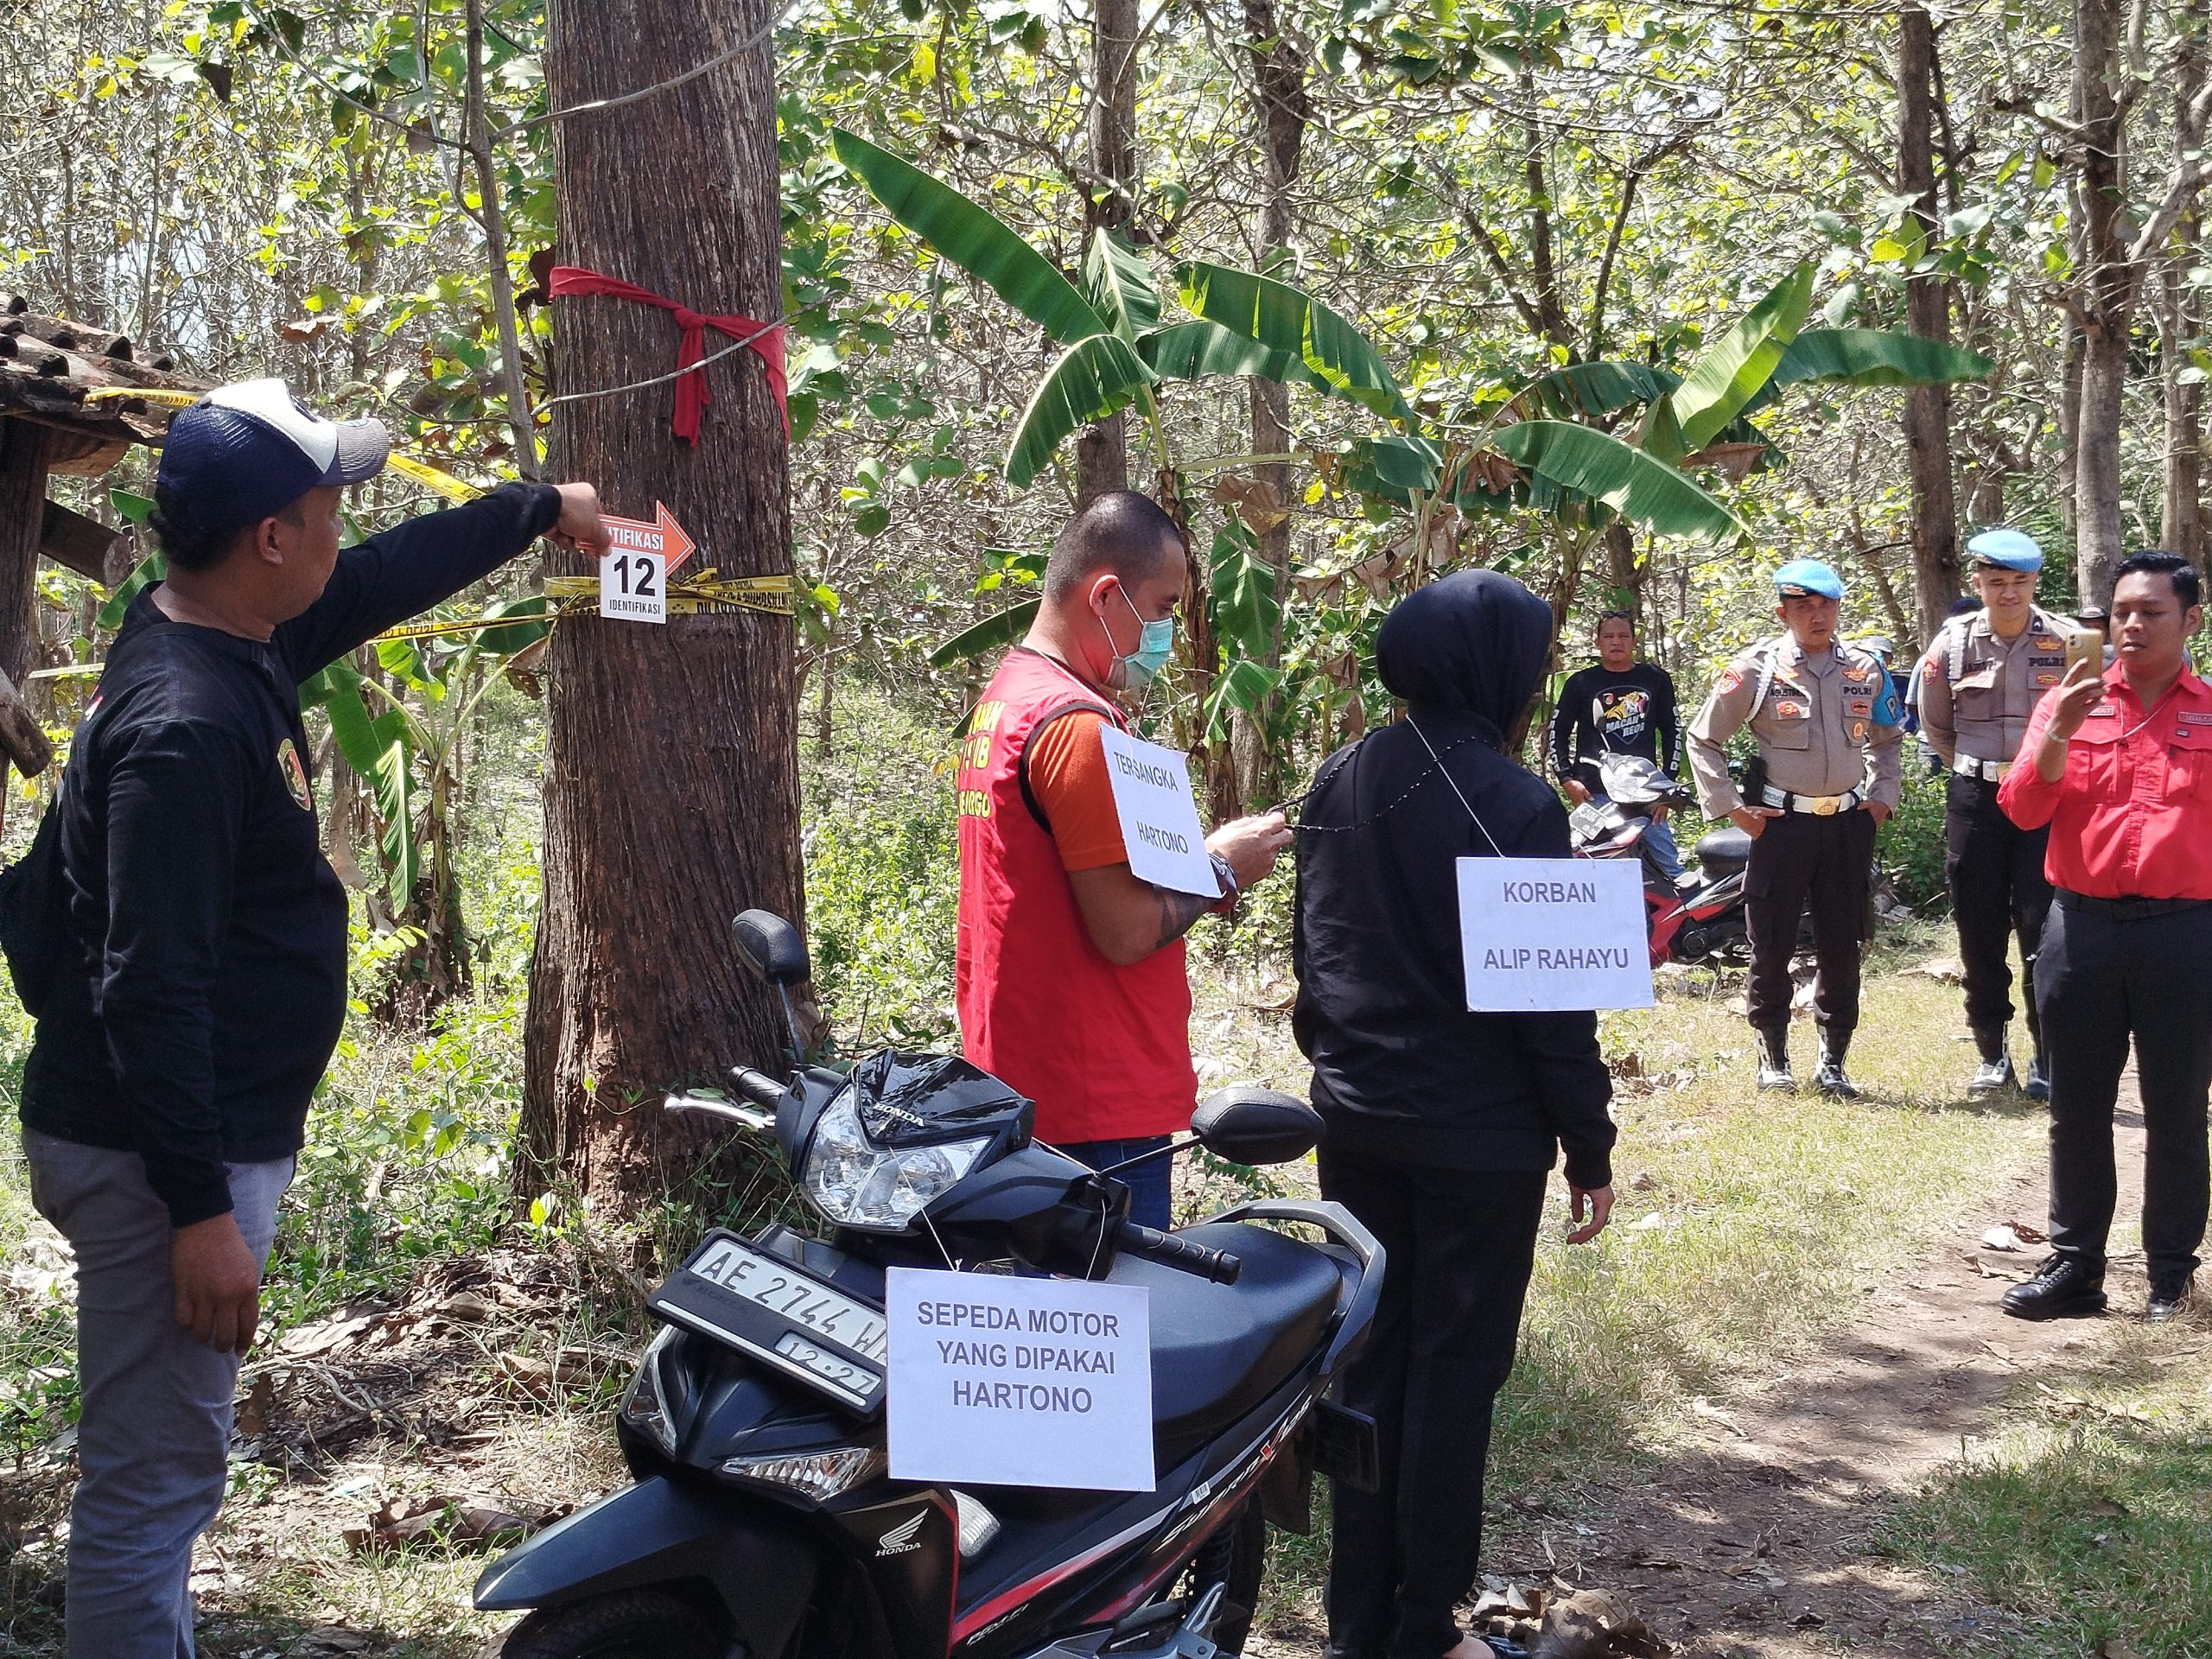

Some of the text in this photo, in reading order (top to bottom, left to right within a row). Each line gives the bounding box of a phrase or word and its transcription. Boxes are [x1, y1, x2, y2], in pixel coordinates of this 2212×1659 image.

[613, 556, 657, 598] 12
[608, 598, 661, 616] IDENTIFIKASI
[1842, 686, 1872, 696] POLRI
[1605, 715, 1639, 734] MACAN
[1114, 752, 1179, 792] TERSANGKA
[1136, 820, 1189, 855] HARTONO
[1503, 881, 1597, 904] KORBAN
[1484, 948, 1629, 969] ALIP RAHAYU
[873, 1103, 925, 1127] HONDA
[701, 1251, 757, 1290] AE
[754, 1277, 850, 1333] 2744
[918, 1301, 1120, 1338] SEPEDA MOTOR
[937, 1340, 1115, 1374] YANG DIPAKAI
[953, 1380, 1092, 1414] HARTONO
[874, 1541, 922, 1557] HONDA
